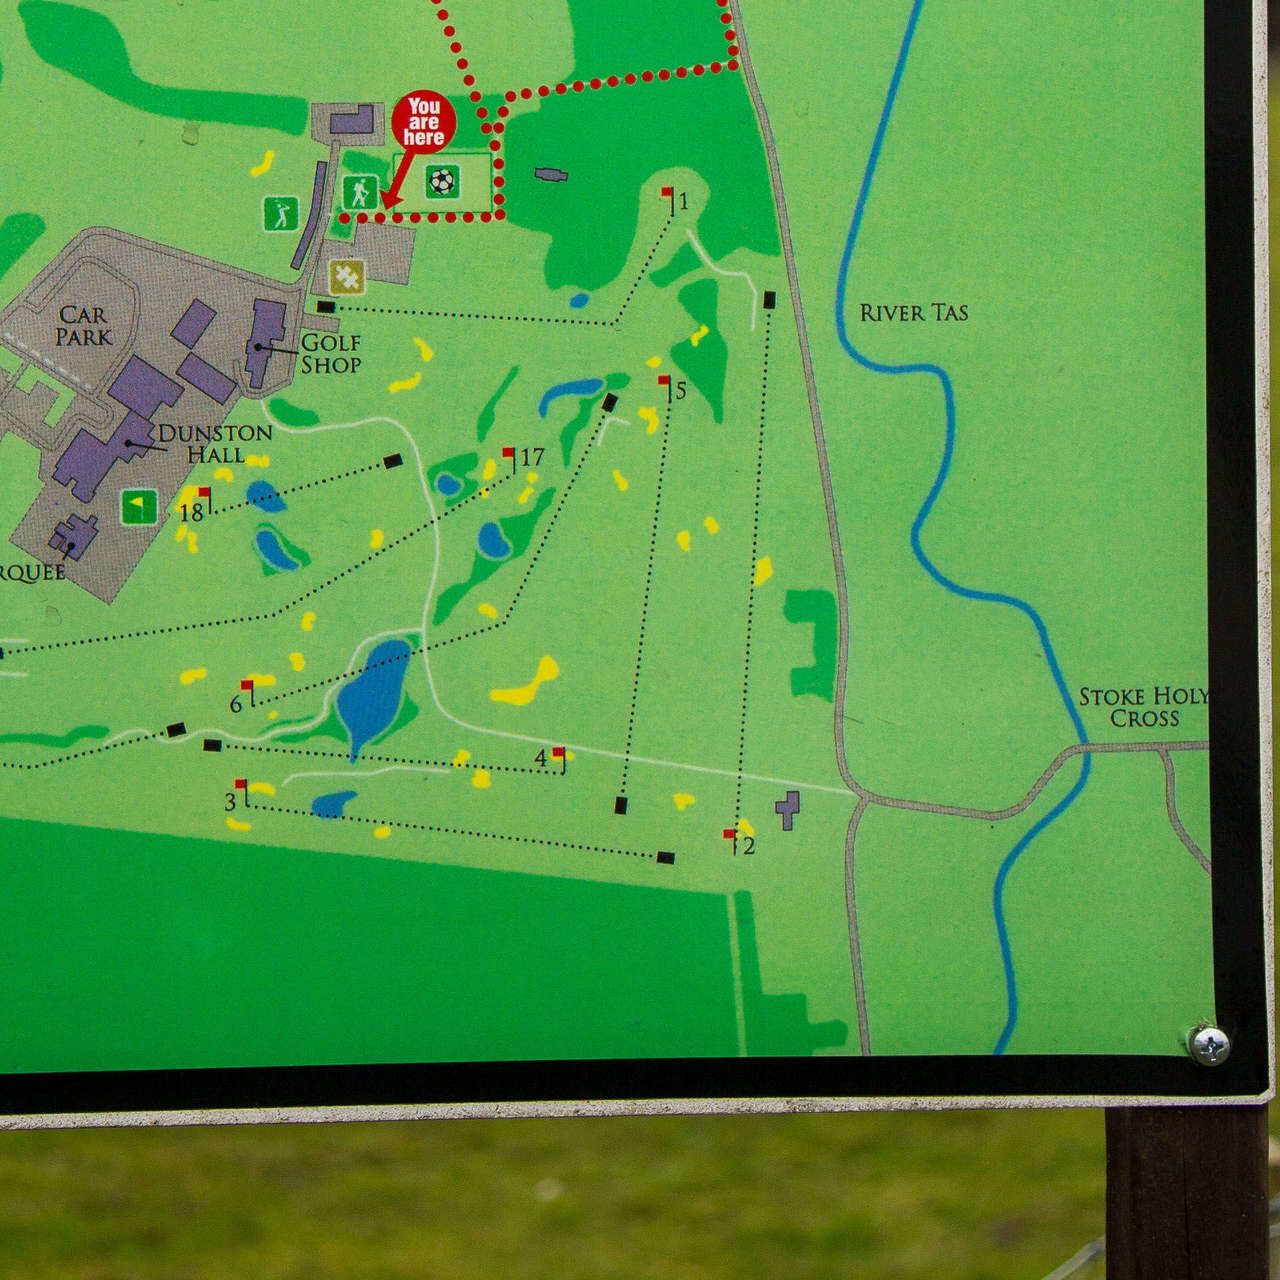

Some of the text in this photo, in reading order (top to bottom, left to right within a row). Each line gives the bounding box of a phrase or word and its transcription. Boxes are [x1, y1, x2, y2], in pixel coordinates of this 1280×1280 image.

[409, 98, 439, 114] You
[410, 117, 438, 129] are
[404, 129, 444, 145] here
[680, 192, 688, 210] 1
[60, 305, 107, 324] CAR
[861, 303, 968, 321] RIVER TAS
[56, 328, 113, 346] PARK
[302, 333, 360, 352] GOLF
[302, 355, 361, 374] SHOP
[677, 381, 686, 400] 5
[158, 425, 273, 443] DUNSTON
[187, 446, 245, 464] HALL
[522, 448, 544, 466] 17
[181, 503, 203, 522] 18
[230, 695, 242, 713] 6
[1080, 687, 1210, 706] STOKE HOLY
[1111, 709, 1179, 727] CROSS
[535, 749, 547, 767] 4
[225, 793, 235, 811] 3
[744, 837, 755, 855] 2
